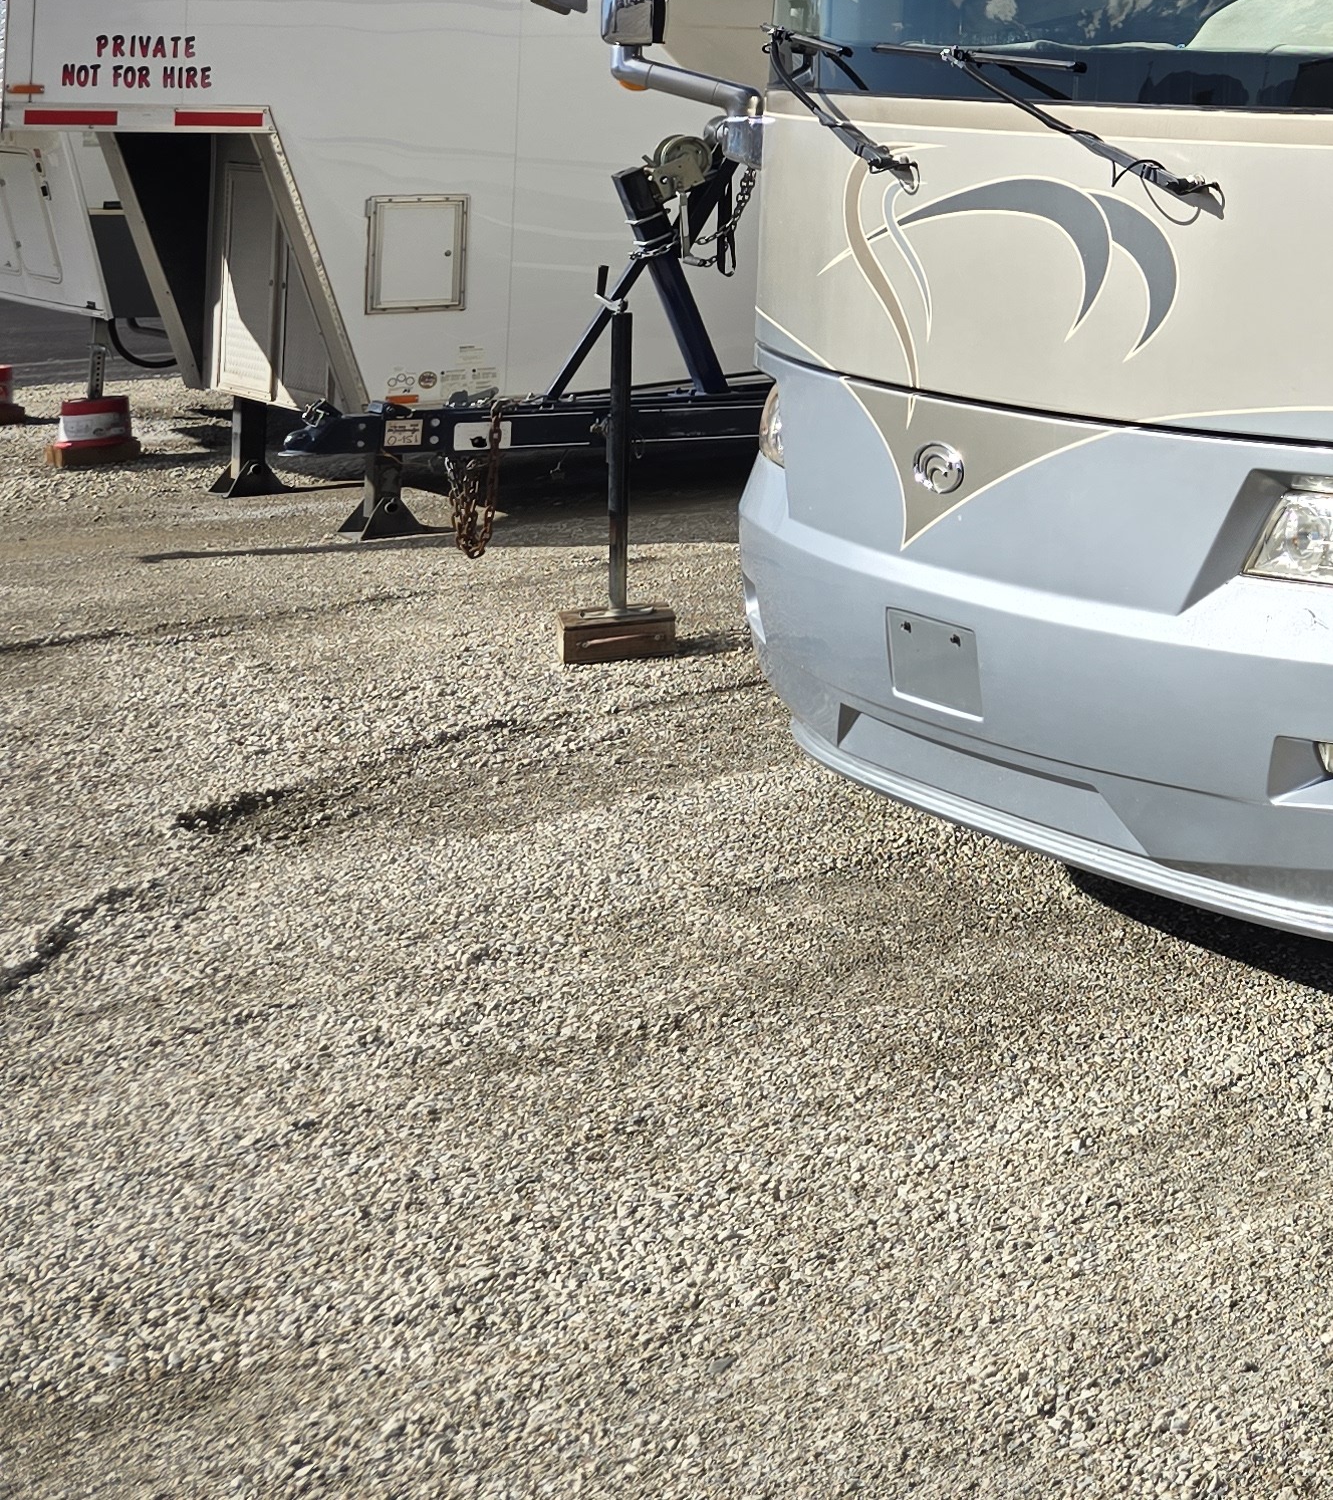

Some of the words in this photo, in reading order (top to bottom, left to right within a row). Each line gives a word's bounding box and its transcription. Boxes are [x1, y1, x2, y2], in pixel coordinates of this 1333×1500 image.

[96, 34, 196, 58] PRIVATE
[61, 63, 101, 87] NOT
[112, 64, 151, 88] FOR
[162, 65, 212, 89] HIRE
